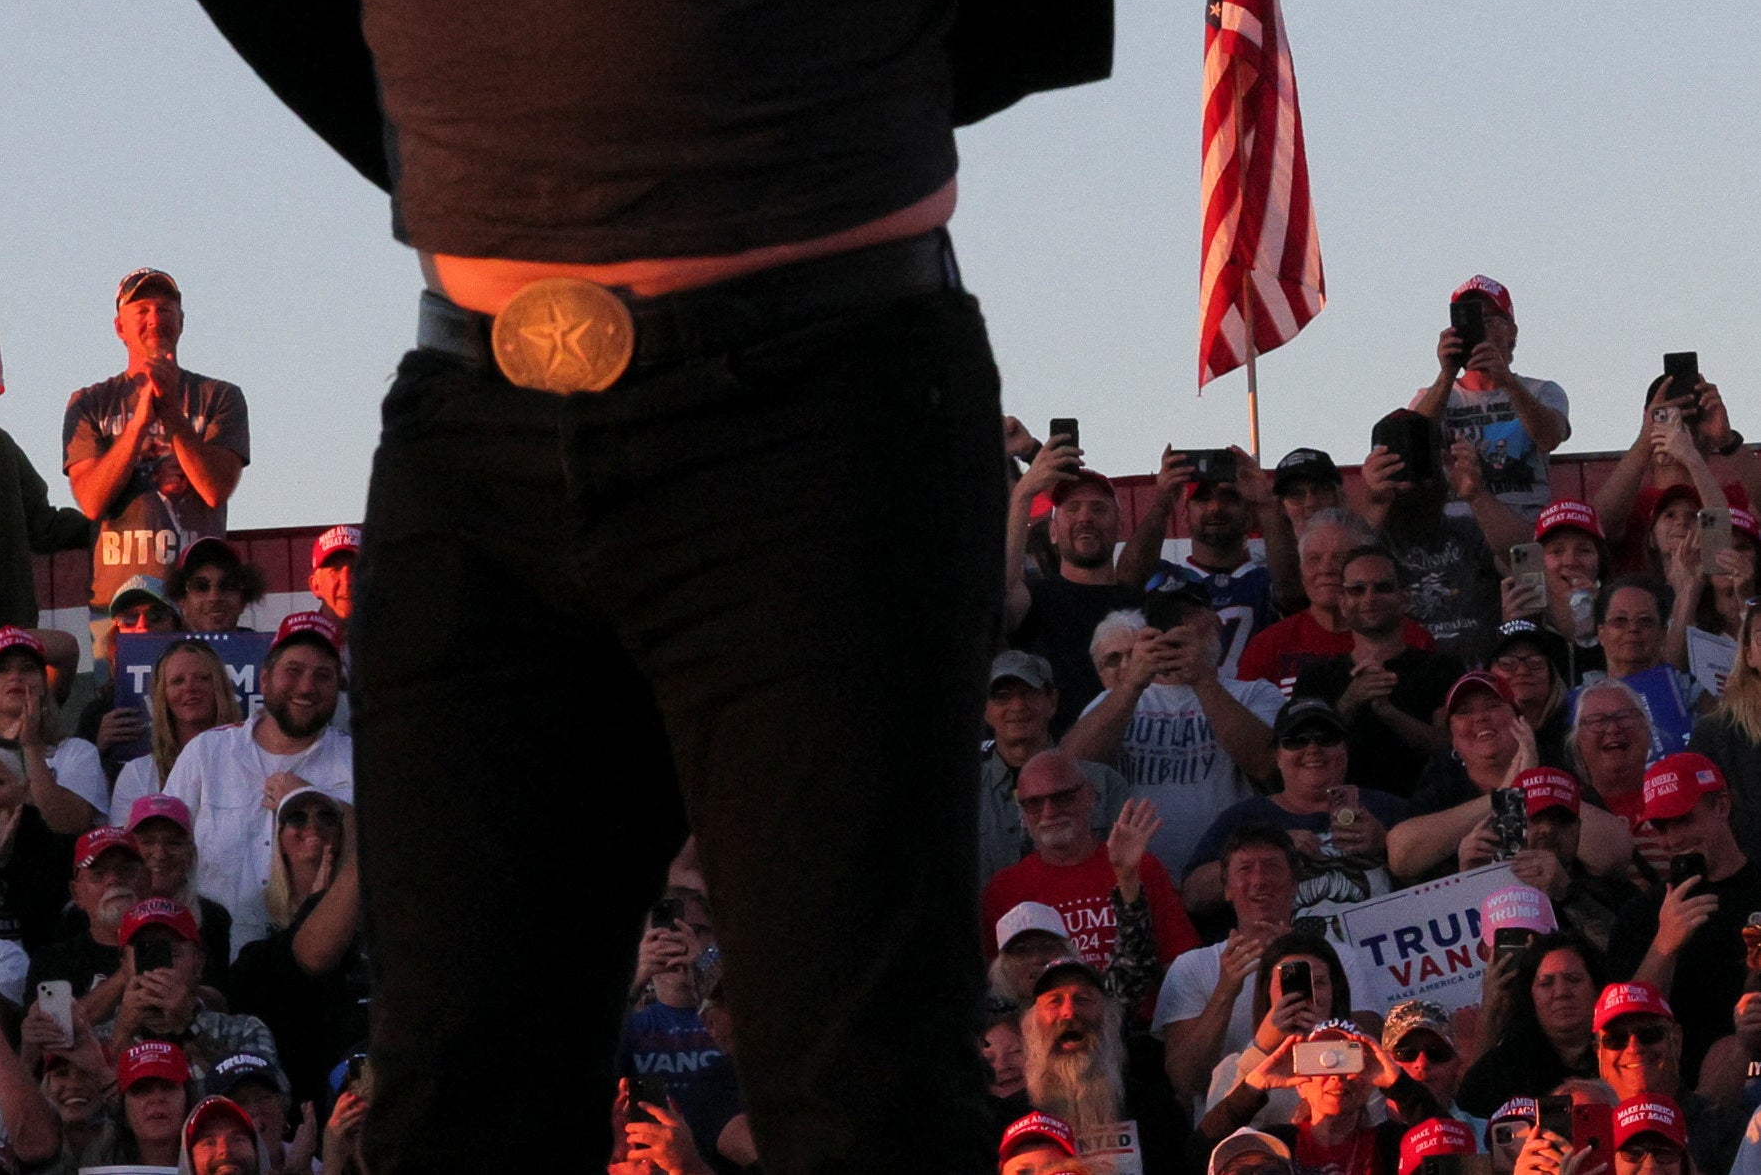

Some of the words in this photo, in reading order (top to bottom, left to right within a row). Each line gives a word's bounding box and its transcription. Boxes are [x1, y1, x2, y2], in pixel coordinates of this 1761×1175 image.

[1540, 508, 1559, 520] MAKE
[1560, 501, 1593, 515] AMERICA
[1542, 512, 1566, 528] GREAT
[1566, 511, 1591, 524] AGAIN
[1523, 774, 1545, 788] MAKE
[1651, 771, 1679, 787] AMERICA
[1527, 787, 1551, 800] GREAT
[1488, 891, 1538, 909] WOMEN
[1490, 905, 1540, 924] TRUMP
[1387, 990, 1416, 1002] MAKE
[1418, 976, 1466, 995] AMERICA
[215, 1053, 268, 1075] TRUMP
[633, 1049, 723, 1074] VANC
[1510, 1092, 1535, 1107] AMER
[1617, 1106, 1639, 1121] MAKE
[1640, 1102, 1676, 1118] AMERICA
[1620, 1112, 1646, 1128] GREAT
[1647, 1112, 1673, 1126] AGAIN
[1008, 1117, 1031, 1137] MAKE
[1031, 1114, 1070, 1132] AMERICA
[1410, 1127, 1431, 1144] MAKE
[1415, 1137, 1438, 1154] GREAT
[1442, 1136, 1465, 1146] AGAIN
